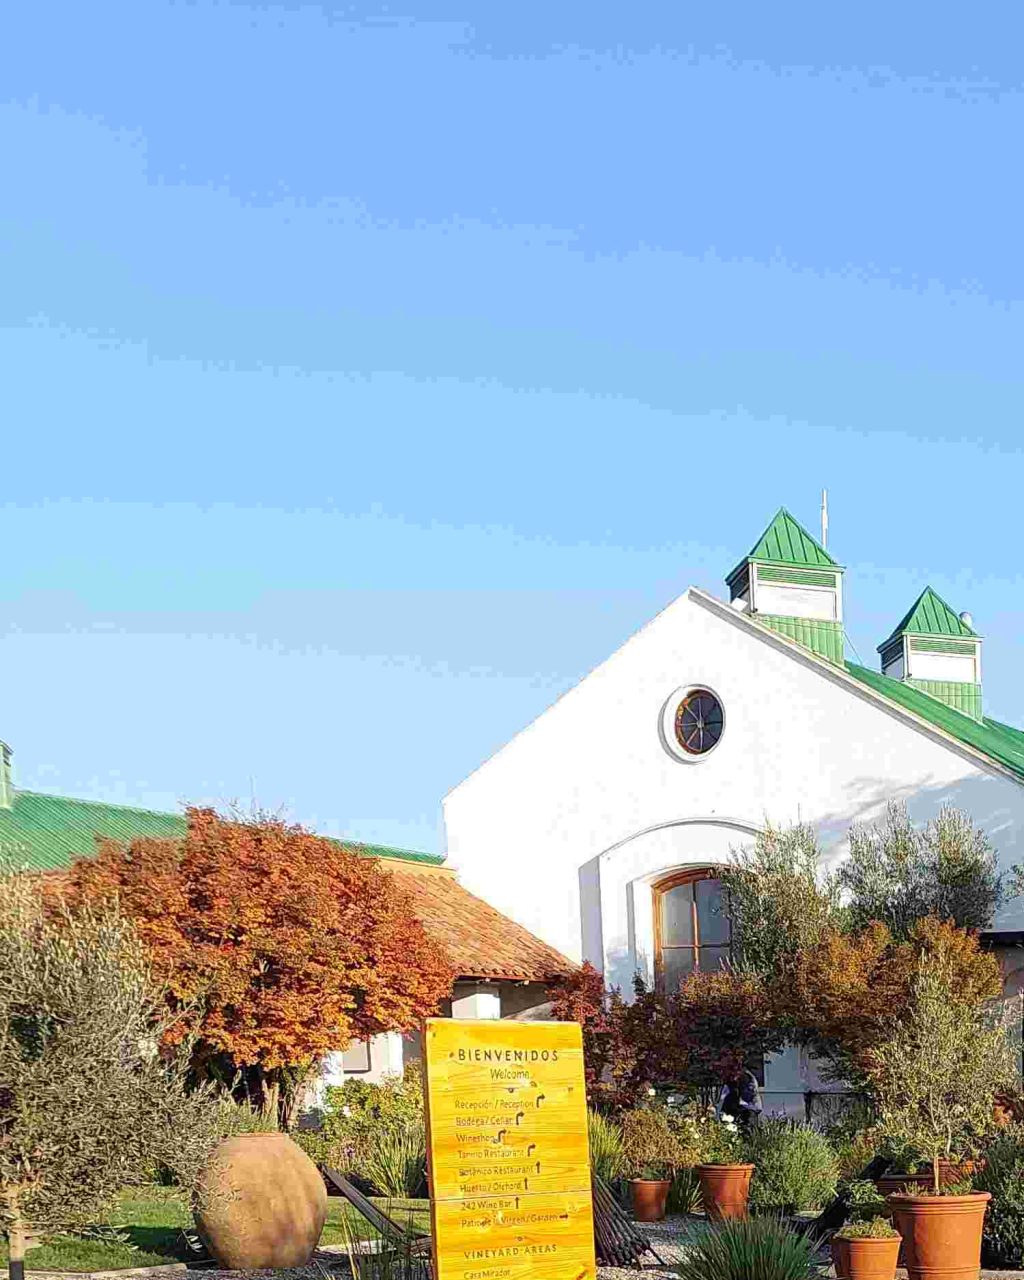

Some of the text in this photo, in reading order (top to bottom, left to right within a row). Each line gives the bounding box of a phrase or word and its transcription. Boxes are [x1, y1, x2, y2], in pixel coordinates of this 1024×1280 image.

[458, 1048, 559, 1062] BIENVENIDOS
[490, 1068, 530, 1080] Welcome
[500, 1098, 534, 1110] Reception
[484, 1149, 525, 1158] Restaurant
[493, 1164, 534, 1175] Restaurant
[460, 1184, 487, 1193] Huerto
[493, 1181, 522, 1191] Orchard
[461, 1201, 476, 1211] 242
[477, 1201, 497, 1210] Wine
[530, 1212, 558, 1222] Garden
[463, 1244, 557, 1259] VINEYARD AREAS
[463, 1268, 511, 1280] Casa Mirador
